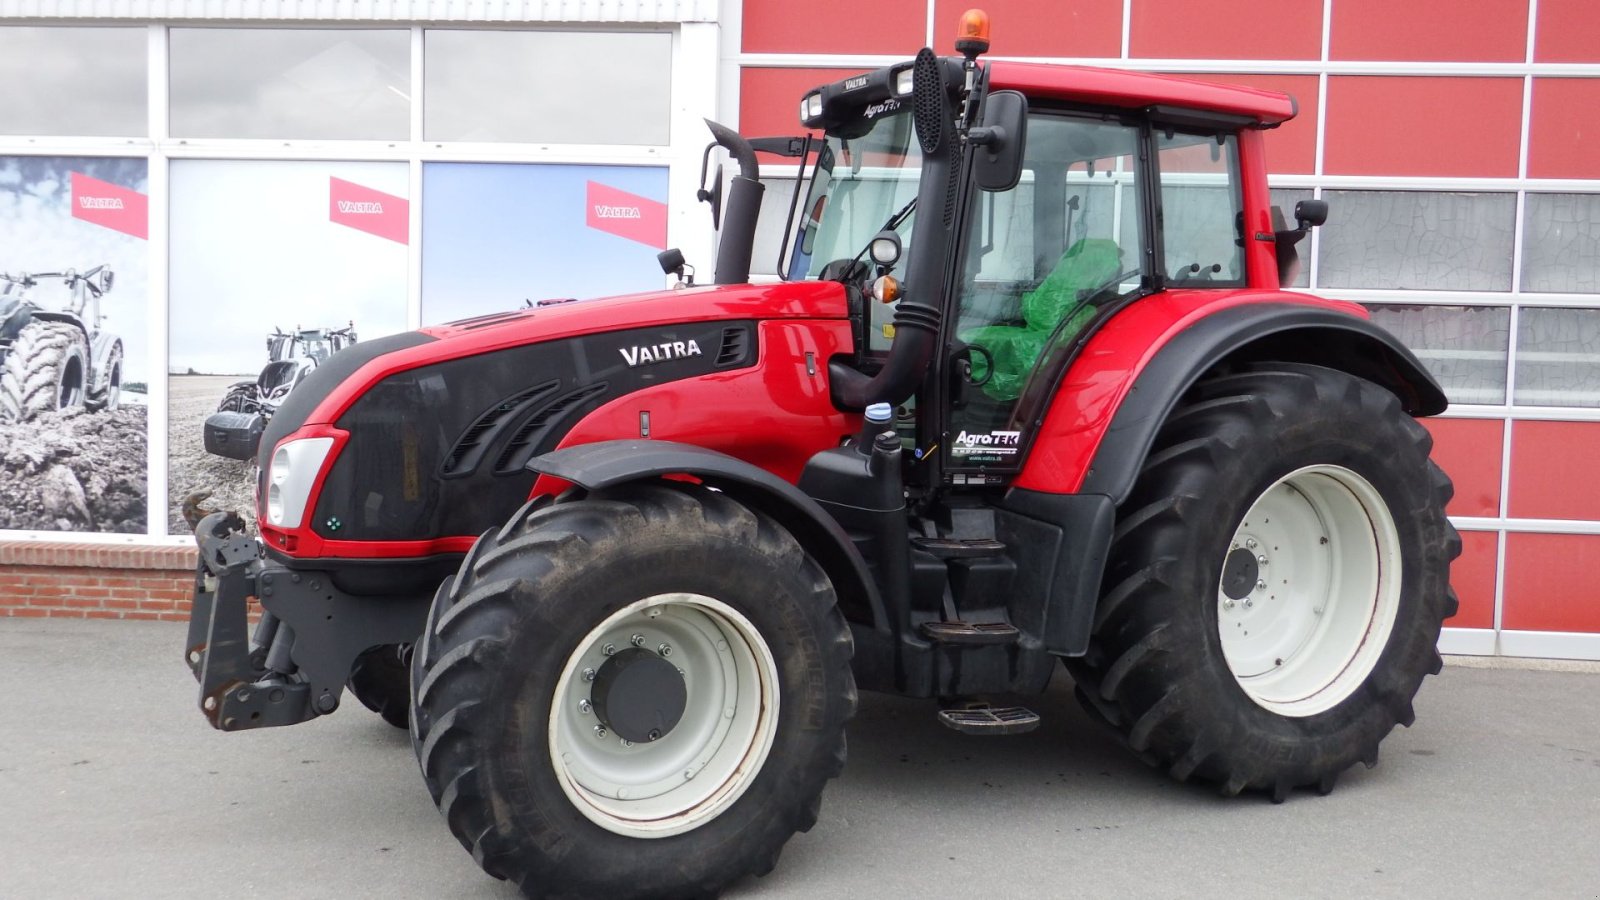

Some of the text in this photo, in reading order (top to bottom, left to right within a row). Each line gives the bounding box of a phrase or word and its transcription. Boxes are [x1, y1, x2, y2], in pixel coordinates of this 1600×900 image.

[845, 77, 867, 90] VALTRA
[79, 196, 124, 210] VALTRA
[338, 200, 383, 214] VALTRA
[595, 205, 641, 219] VALTRA
[619, 339, 702, 367] VALTRA
[955, 430, 1021, 447] AgroTEK
